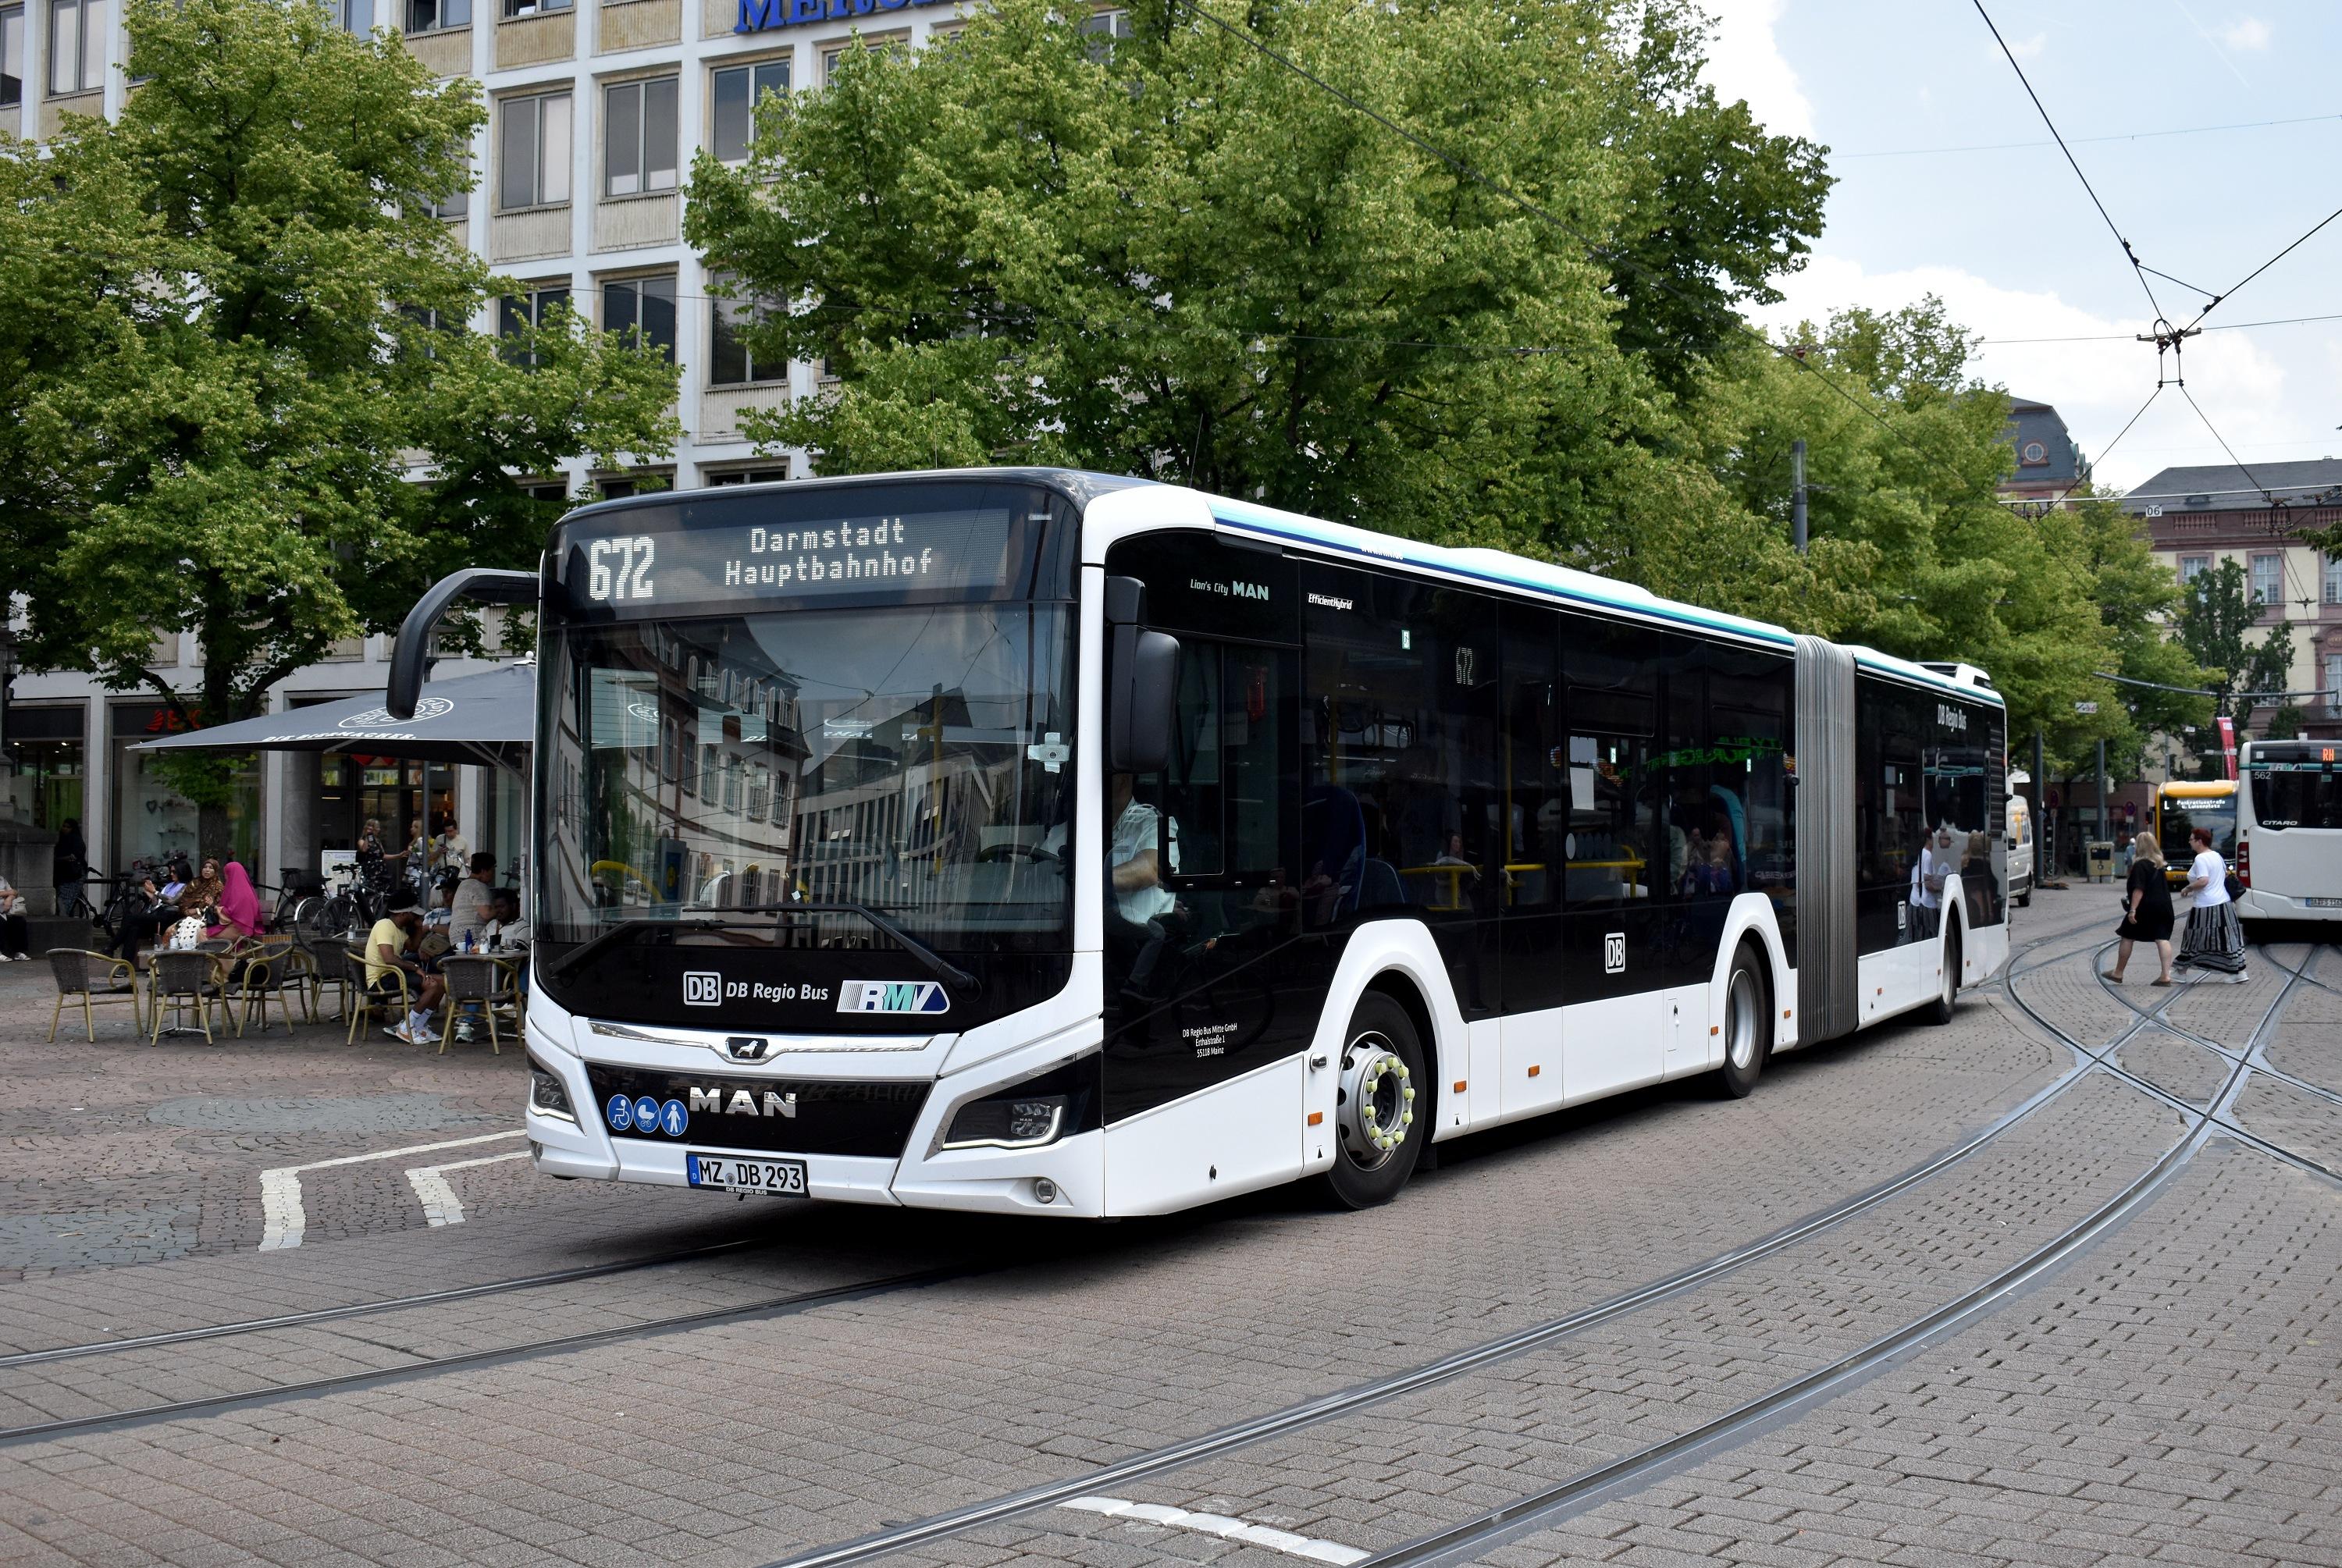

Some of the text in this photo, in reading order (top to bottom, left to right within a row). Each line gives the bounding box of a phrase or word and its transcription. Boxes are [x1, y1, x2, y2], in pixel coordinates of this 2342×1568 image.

[2148, 507, 2160, 516] 06
[751, 518, 904, 553] Darmstadt
[589, 537, 654, 600] 672
[725, 548, 932, 587] Hauptbahnhof
[1190, 578, 1269, 601] Lion's City MAN
[1308, 593, 1353, 610] EfficientHybrid
[1455, 646, 1473, 685] 672
[1938, 703, 1945, 724] DB
[1945, 706, 1958, 732] Regio
[2322, 748, 2335, 762] RH
[2254, 771, 2272, 780] 562
[2164, 800, 2170, 810] L
[1607, 939, 1623, 967] DB
[688, 976, 717, 1002] DB
[726, 982, 828, 1003] DB Regio Bus
[858, 983, 937, 1012] RMV
[1183, 1022, 1237, 1038] DB Regio Bus Mitte GmbH
[1195, 1035, 1223, 1047] Erthalstraße
[1197, 1047, 1224, 1058] 55118 Mainz
[689, 1086, 796, 1118] MAN
[699, 1160, 801, 1189] MZ DB 293
